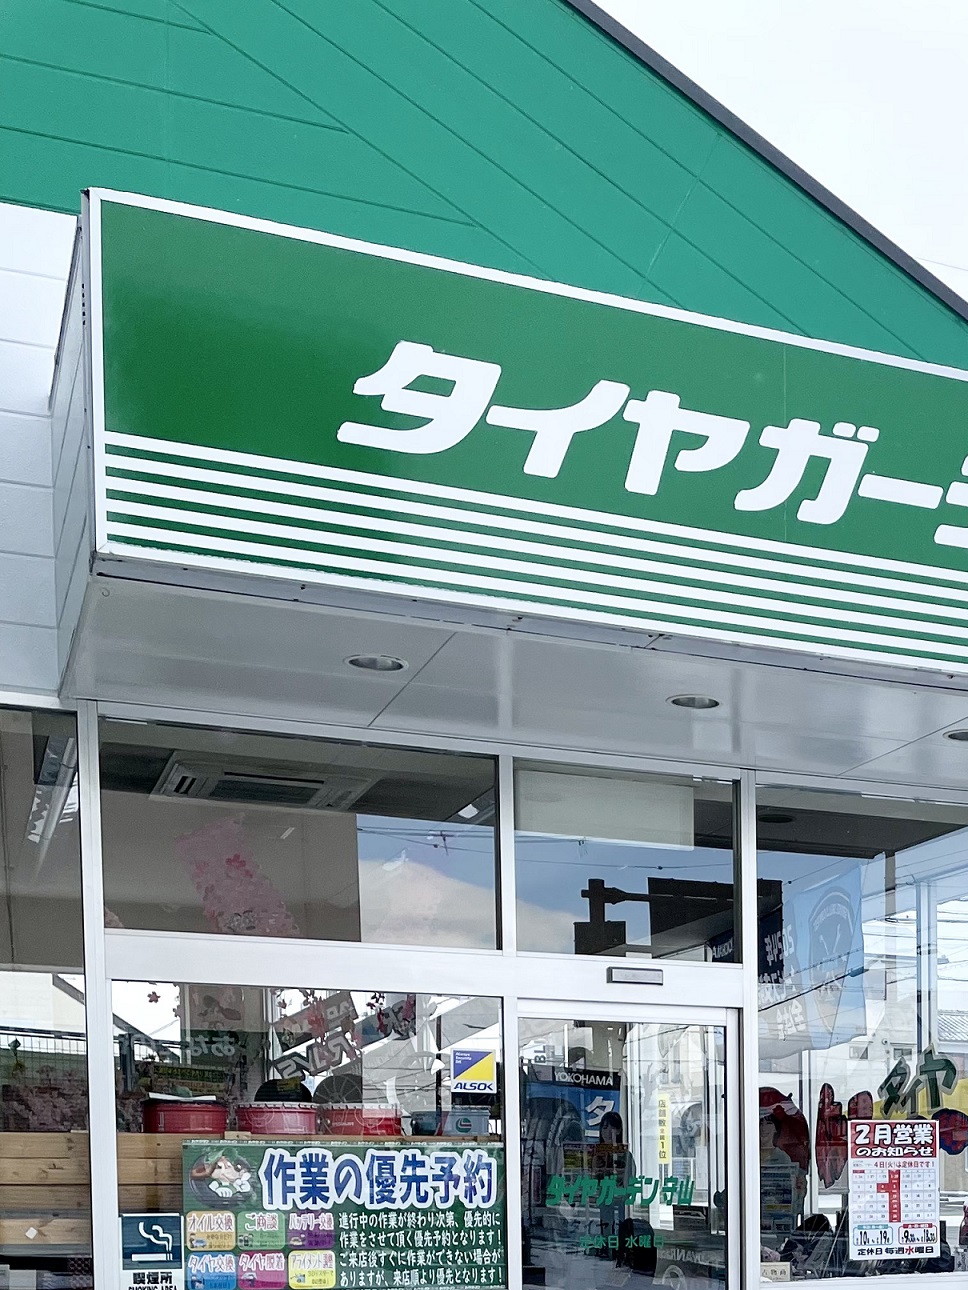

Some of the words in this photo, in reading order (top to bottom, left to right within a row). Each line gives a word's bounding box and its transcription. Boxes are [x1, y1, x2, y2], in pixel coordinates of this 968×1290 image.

[454, 1082, 493, 1091] ALSOK
[554, 1071, 613, 1086] YOKOHAMA
[855, 1124, 933, 1145] 2月営業
[856, 1146, 933, 1157] のお知らせ
[260, 1149, 496, 1209] 作業の優先予約
[546, 1174, 659, 1206] タイヤガーデン
[661, 1175, 695, 1206] 守山
[188, 1213, 234, 1232] オイル交換
[244, 1212, 279, 1231] ご商談
[579, 1236, 620, 1249] 定休日
[625, 1235, 664, 1248] 水曜日
[857, 1247, 883, 1256] 定休日
[885, 1246, 934, 1255] 毎週水曜日
[188, 1252, 236, 1274] タイヤ交換
[239, 1252, 285, 1272] タイヤ脱着
[133, 1271, 172, 1284] 喫煙所
